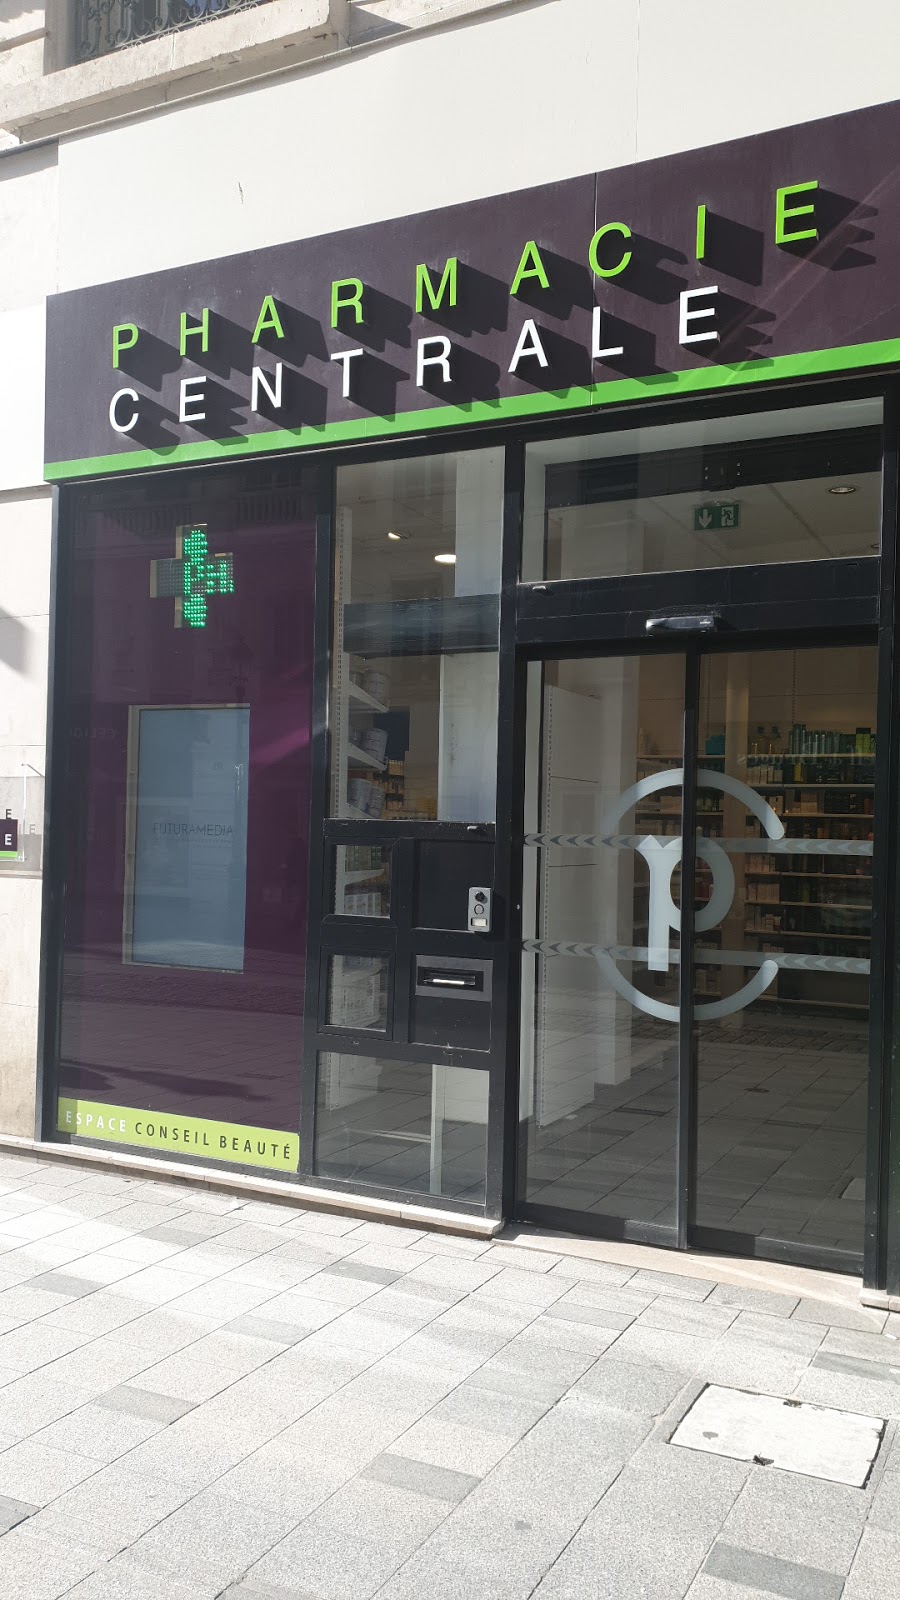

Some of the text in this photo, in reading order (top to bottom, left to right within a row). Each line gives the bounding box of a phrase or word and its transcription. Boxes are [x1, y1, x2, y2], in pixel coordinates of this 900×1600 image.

[112, 180, 819, 368] PHARMACIE
[109, 285, 720, 433] CENTRALE
[152, 822, 233, 837] FUTURAMEDIA
[65, 1110, 291, 1160] ESPACE CONSEIL BEAUTÉ
